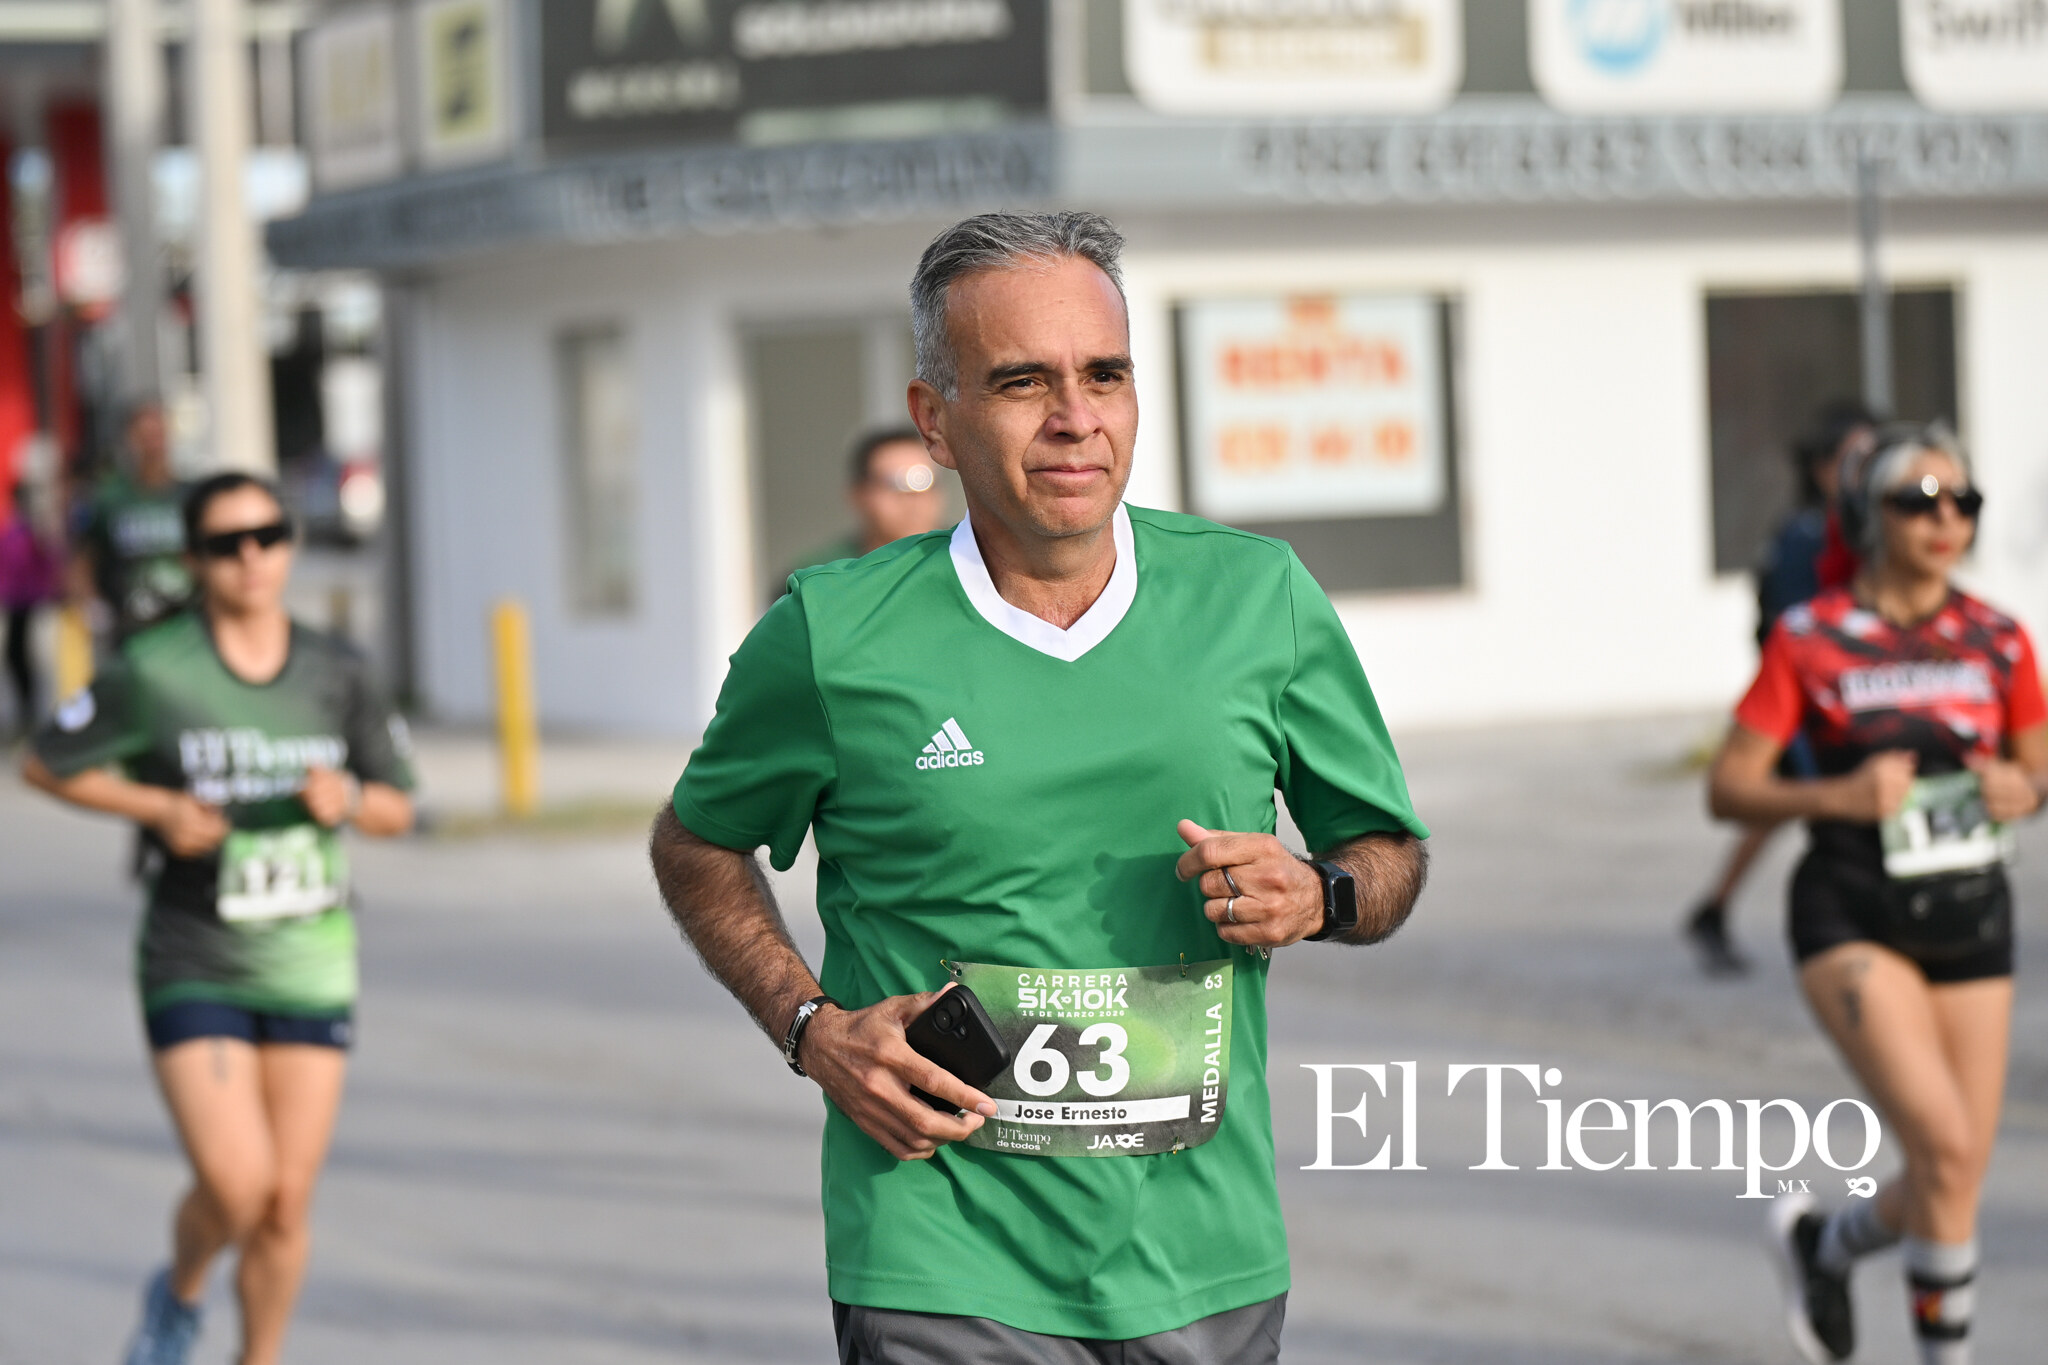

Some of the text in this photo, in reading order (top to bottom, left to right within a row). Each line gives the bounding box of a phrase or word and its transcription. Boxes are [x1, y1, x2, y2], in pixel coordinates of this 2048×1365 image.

[915, 750, 985, 770] adidas
[1017, 973, 1128, 988] CARRERA
[1204, 974, 1223, 990] 63
[1022, 1009, 1035, 1017] 15
[1039, 1010, 1053, 1018] DE
[1099, 1009, 1125, 1017] 2026
[1013, 1022, 1131, 1098] 63
[1200, 1002, 1223, 1124] MEDALLA
[1015, 1104, 1128, 1121] Jose Ernesto
[997, 1126, 1051, 1145] El Tiempo
[996, 1139, 1041, 1151] de todos
